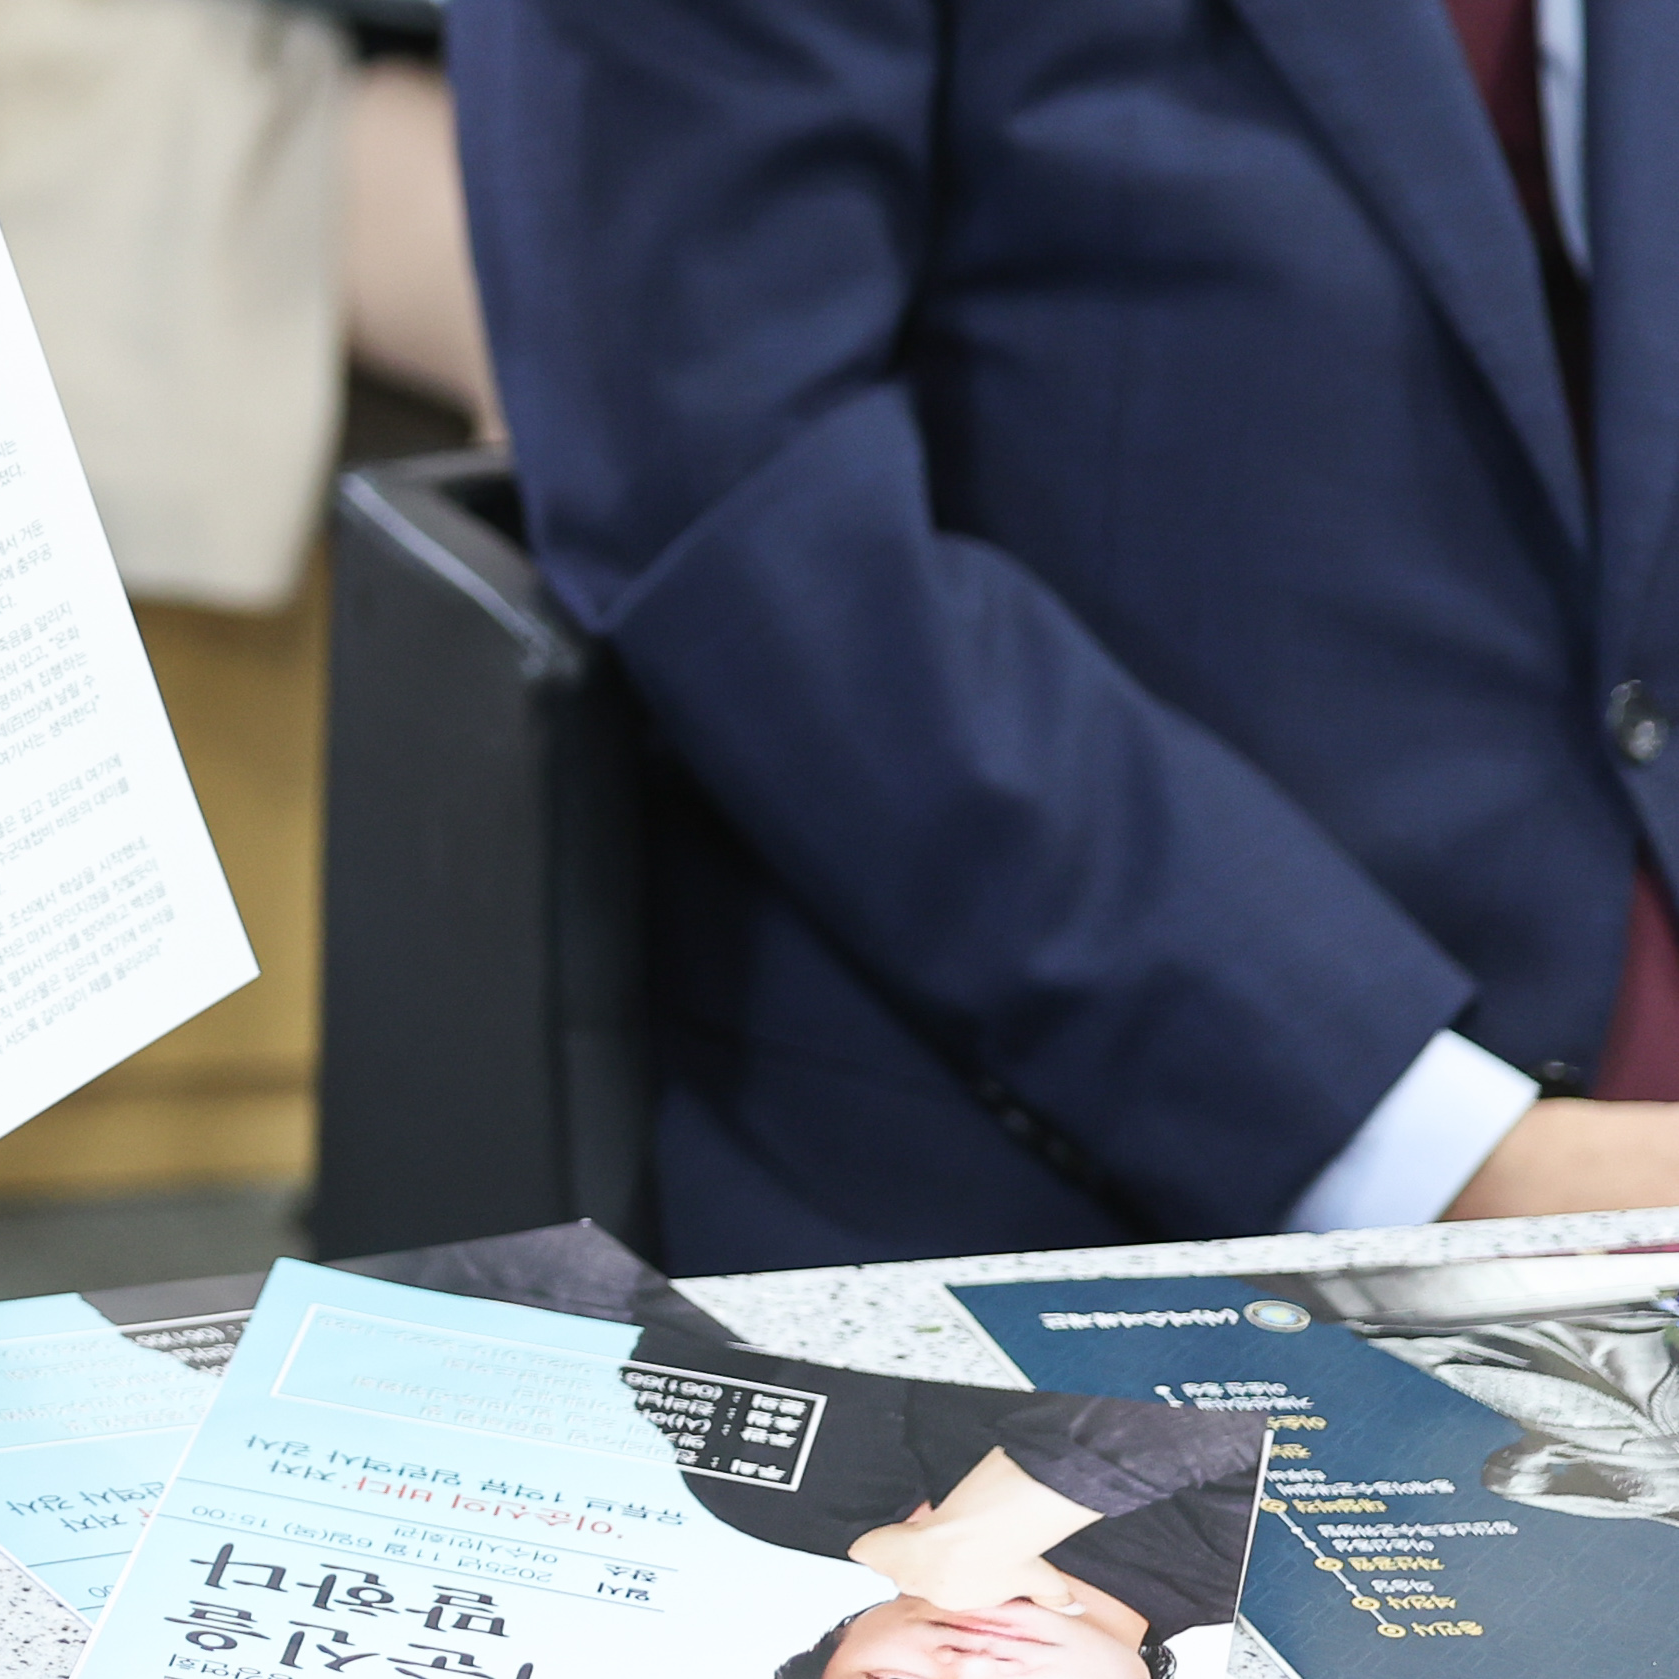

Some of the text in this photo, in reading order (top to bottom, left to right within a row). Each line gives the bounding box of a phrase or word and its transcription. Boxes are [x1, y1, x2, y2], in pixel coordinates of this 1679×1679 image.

[5, 1495, 74, 1515] 강사
[244, 1431, 684, 1527] 유튜브 1억뷰 임란역사 강사
[267, 1457, 338, 1483] 저자
[59, 1513, 127, 1533] 저자
[189, 1503, 651, 1603] 일시 2025년 11월 6일(목) 15:00
[391, 1524, 659, 1584] 장소 여수시민회관
[188, 1541, 509, 1638] 말한다
[160, 1599, 534, 1679] 순신을
